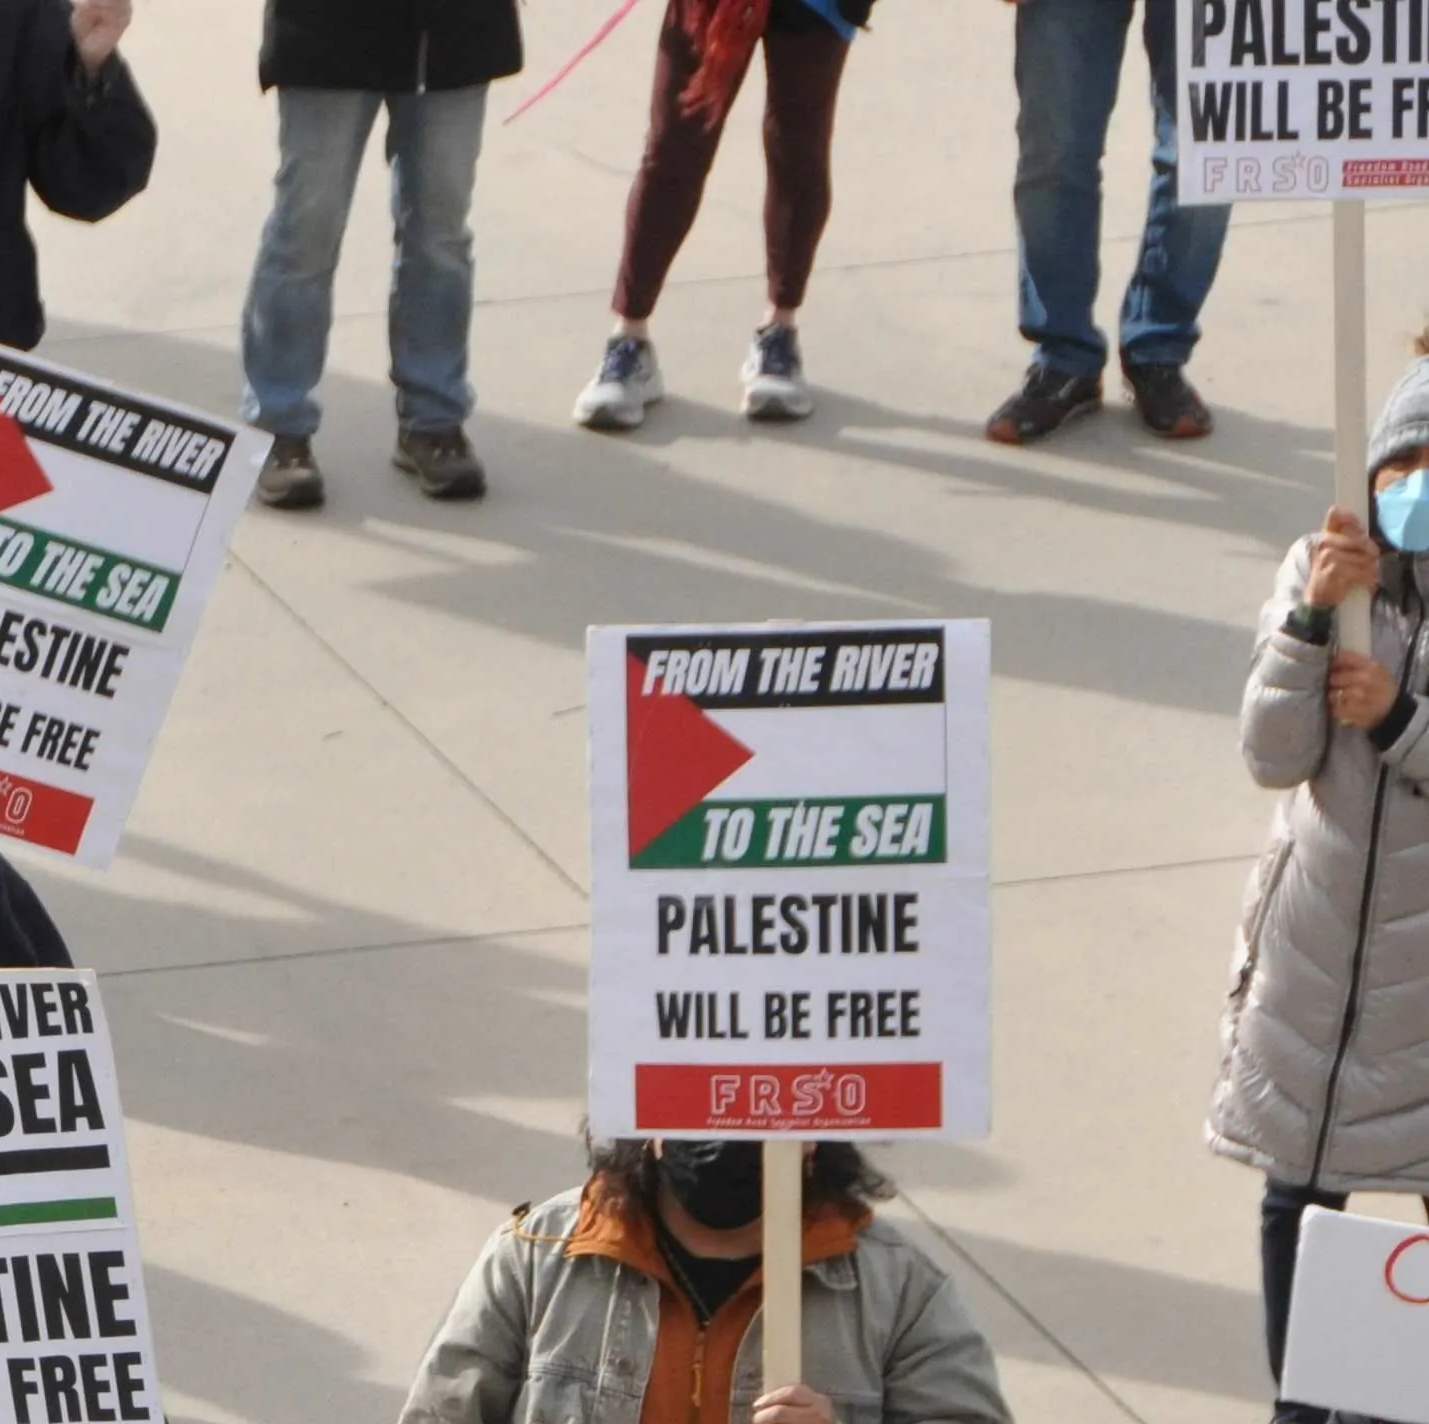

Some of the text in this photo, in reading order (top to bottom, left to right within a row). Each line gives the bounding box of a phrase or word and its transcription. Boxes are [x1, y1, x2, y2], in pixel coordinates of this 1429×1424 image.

[1191, 0, 1429, 68] PALESTI
[1188, 80, 1299, 142] WILL
[1317, 79, 1373, 140] BE
[1203, 155, 1329, 193] FRSO
[76, 402, 138, 453] THE
[130, 420, 227, 482] RIVER
[29, 541, 105, 599] THE
[94, 562, 172, 624] SEA
[642, 640, 940, 697] FROM THE RIVER
[20, 710, 102, 773] FREE
[701, 801, 934, 861] TO THE SEA
[656, 892, 920, 957] PALESTINE
[655, 989, 921, 1040] WILL BE FREE
[710, 1073, 866, 1116] FRSO
[7, 1352, 151, 1424] FREE
